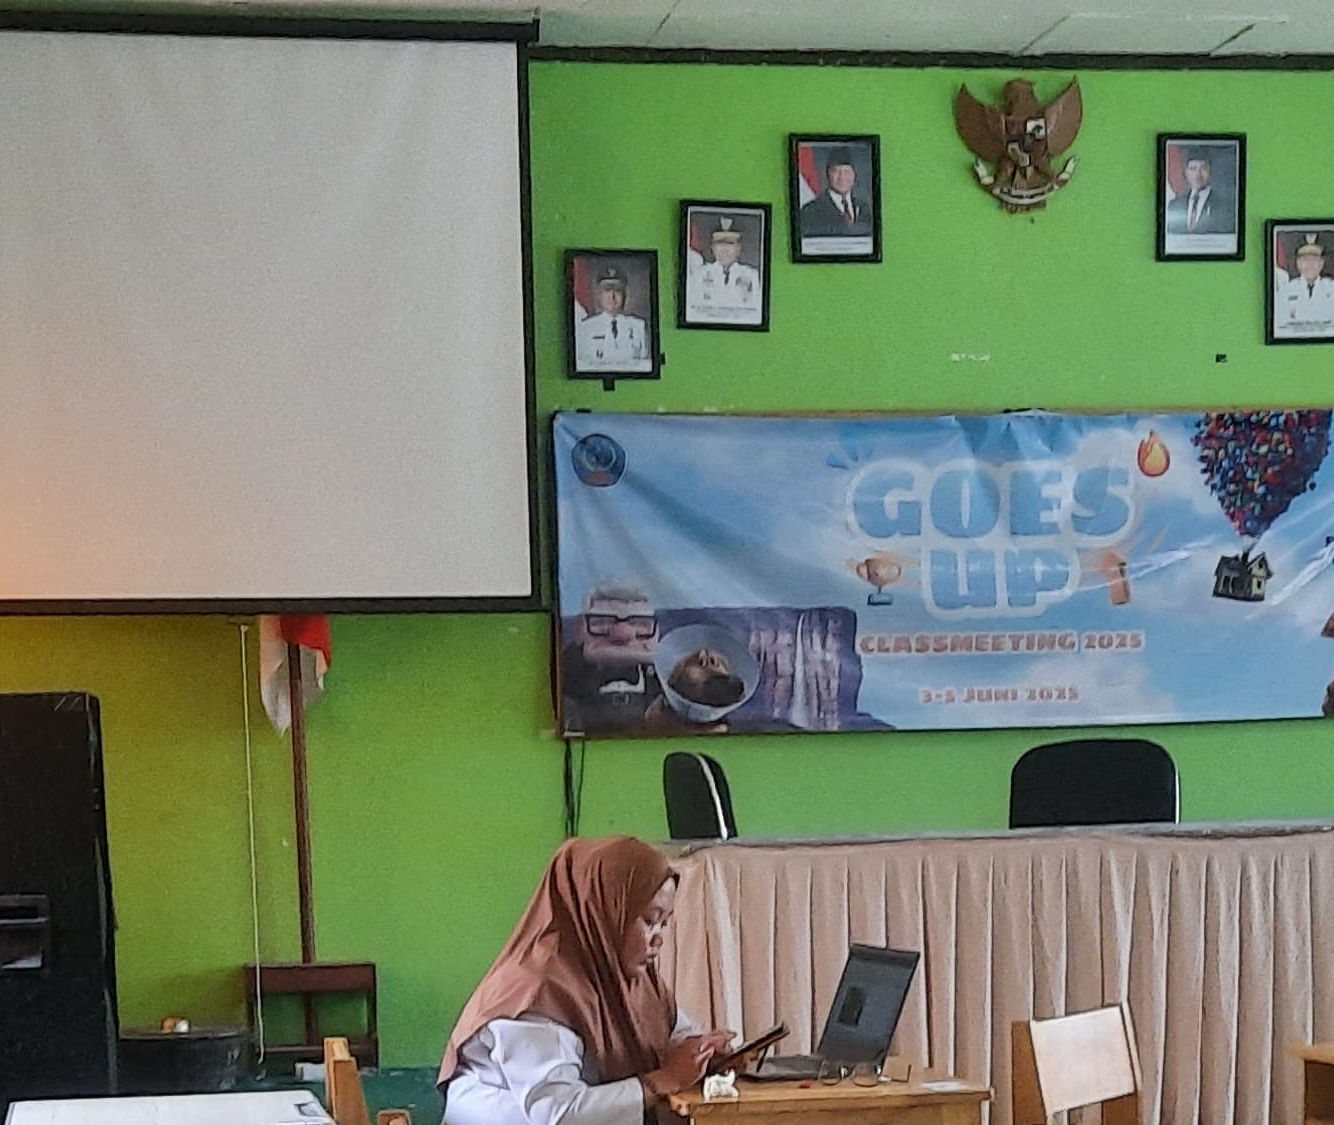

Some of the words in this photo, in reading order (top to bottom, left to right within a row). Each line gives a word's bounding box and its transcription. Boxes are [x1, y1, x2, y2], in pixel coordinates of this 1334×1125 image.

[851, 464, 1131, 539] GOES
[929, 550, 1069, 608] UP
[859, 632, 1076, 653] CLASSMEETING
[1083, 631, 1142, 650] 2025
[962, 686, 1018, 703] JUNI
[1026, 686, 1080, 702] 2025
